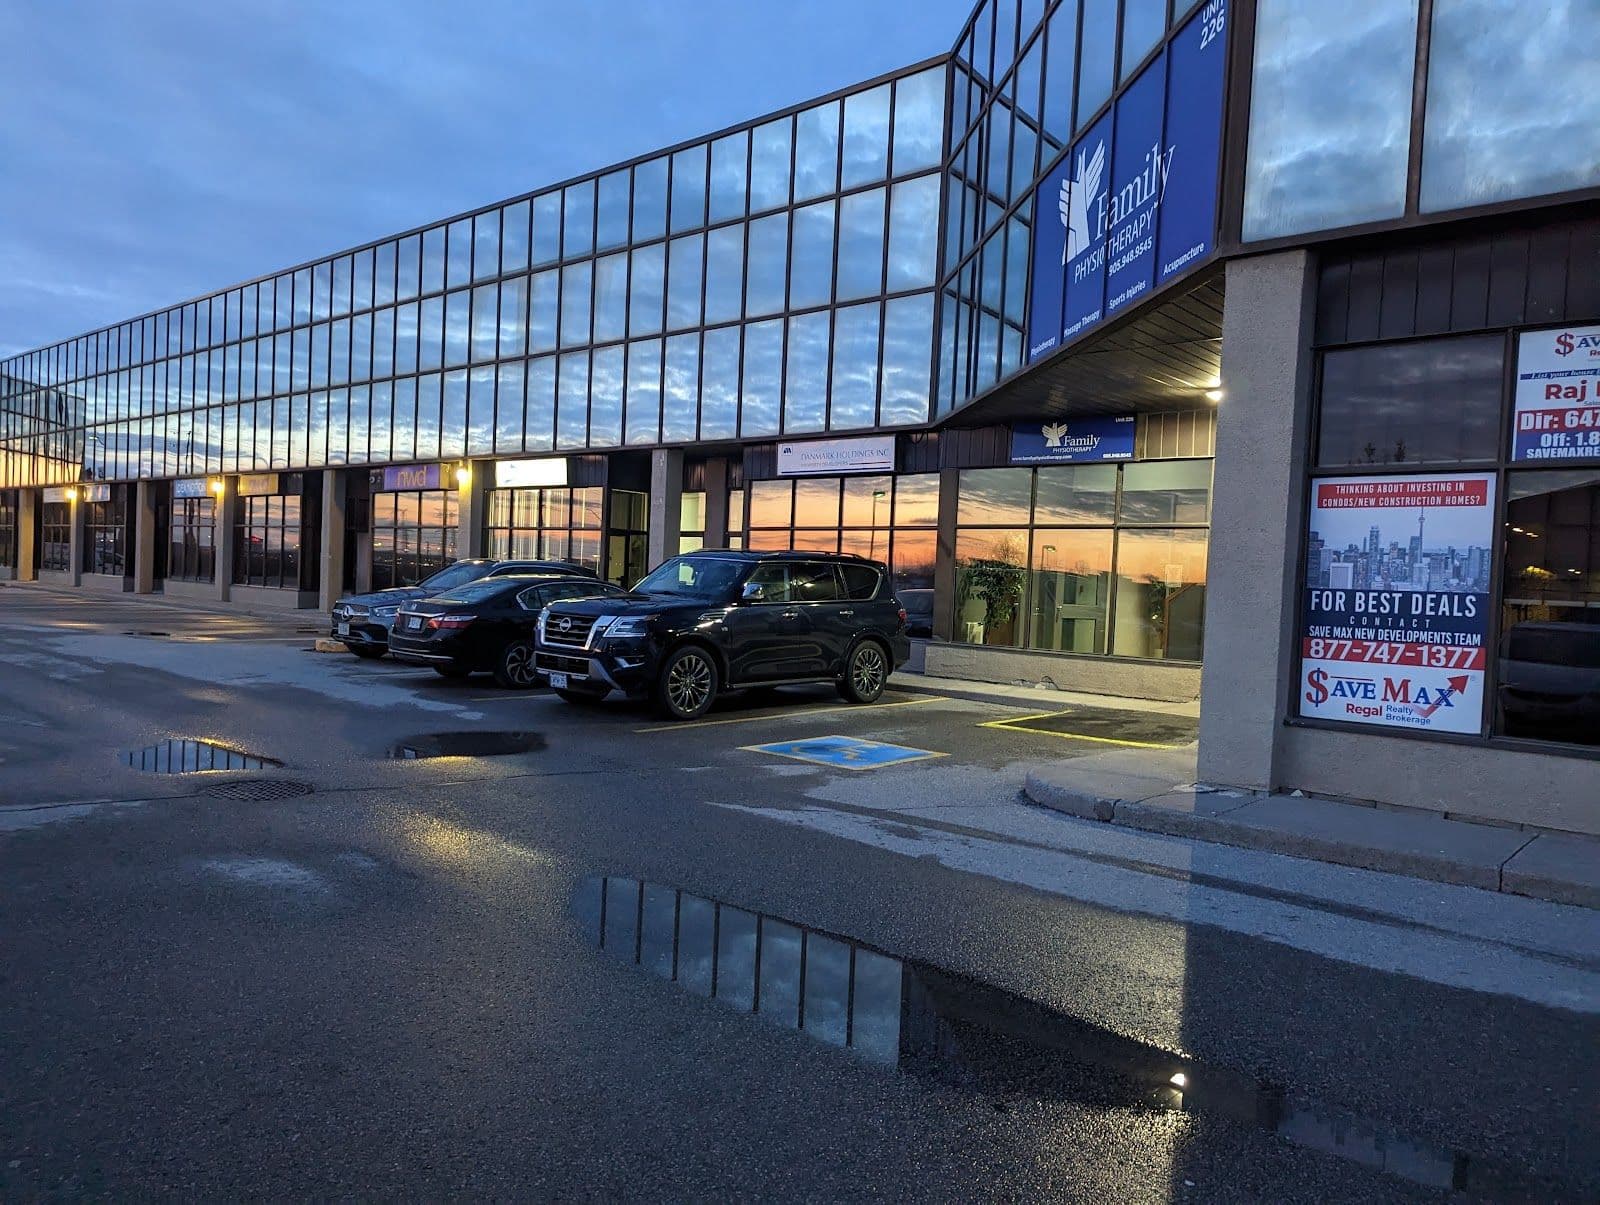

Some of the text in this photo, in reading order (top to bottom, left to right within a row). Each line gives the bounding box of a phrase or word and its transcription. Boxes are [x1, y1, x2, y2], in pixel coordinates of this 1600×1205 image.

[1200, 8, 1225, 50] 226
[1094, 142, 1176, 241] Family
[1074, 206, 1154, 284] PHYSIOTHERAPY
[1108, 235, 1153, 277] 905.948.9545
[1162, 242, 1205, 276] Acupuncture
[1108, 279, 1146, 310] Sports Injuries
[1081, 309, 1101, 326] Therapy
[1545, 379, 1587, 402] Raj
[1520, 412, 1559, 431] Dir:
[1063, 434, 1101, 449] Family
[1540, 431, 1600, 447] Off: 1.8
[1052, 446, 1092, 454] PHYSIOTHERAPY
[1526, 446, 1600, 459] SAVEMAXRE
[1335, 482, 1465, 495] THINKING ABOUT INVESTING IN
[1322, 495, 1481, 508] CONDOS/NEW CONSTRUCTION HOMES?
[1310, 590, 1477, 618] FOR BEST DEALS
[1350, 615, 1431, 629] CONTACT
[1308, 625, 1481, 646] SAVE MAX NEW DEVELOPMENTS TEAM
[1310, 638, 1479, 669] 877-747-1377
[1381, 677, 1455, 707] MAX
[1346, 703, 1414, 716] Regal Realty
[1385, 713, 1431, 725] Brokerage
